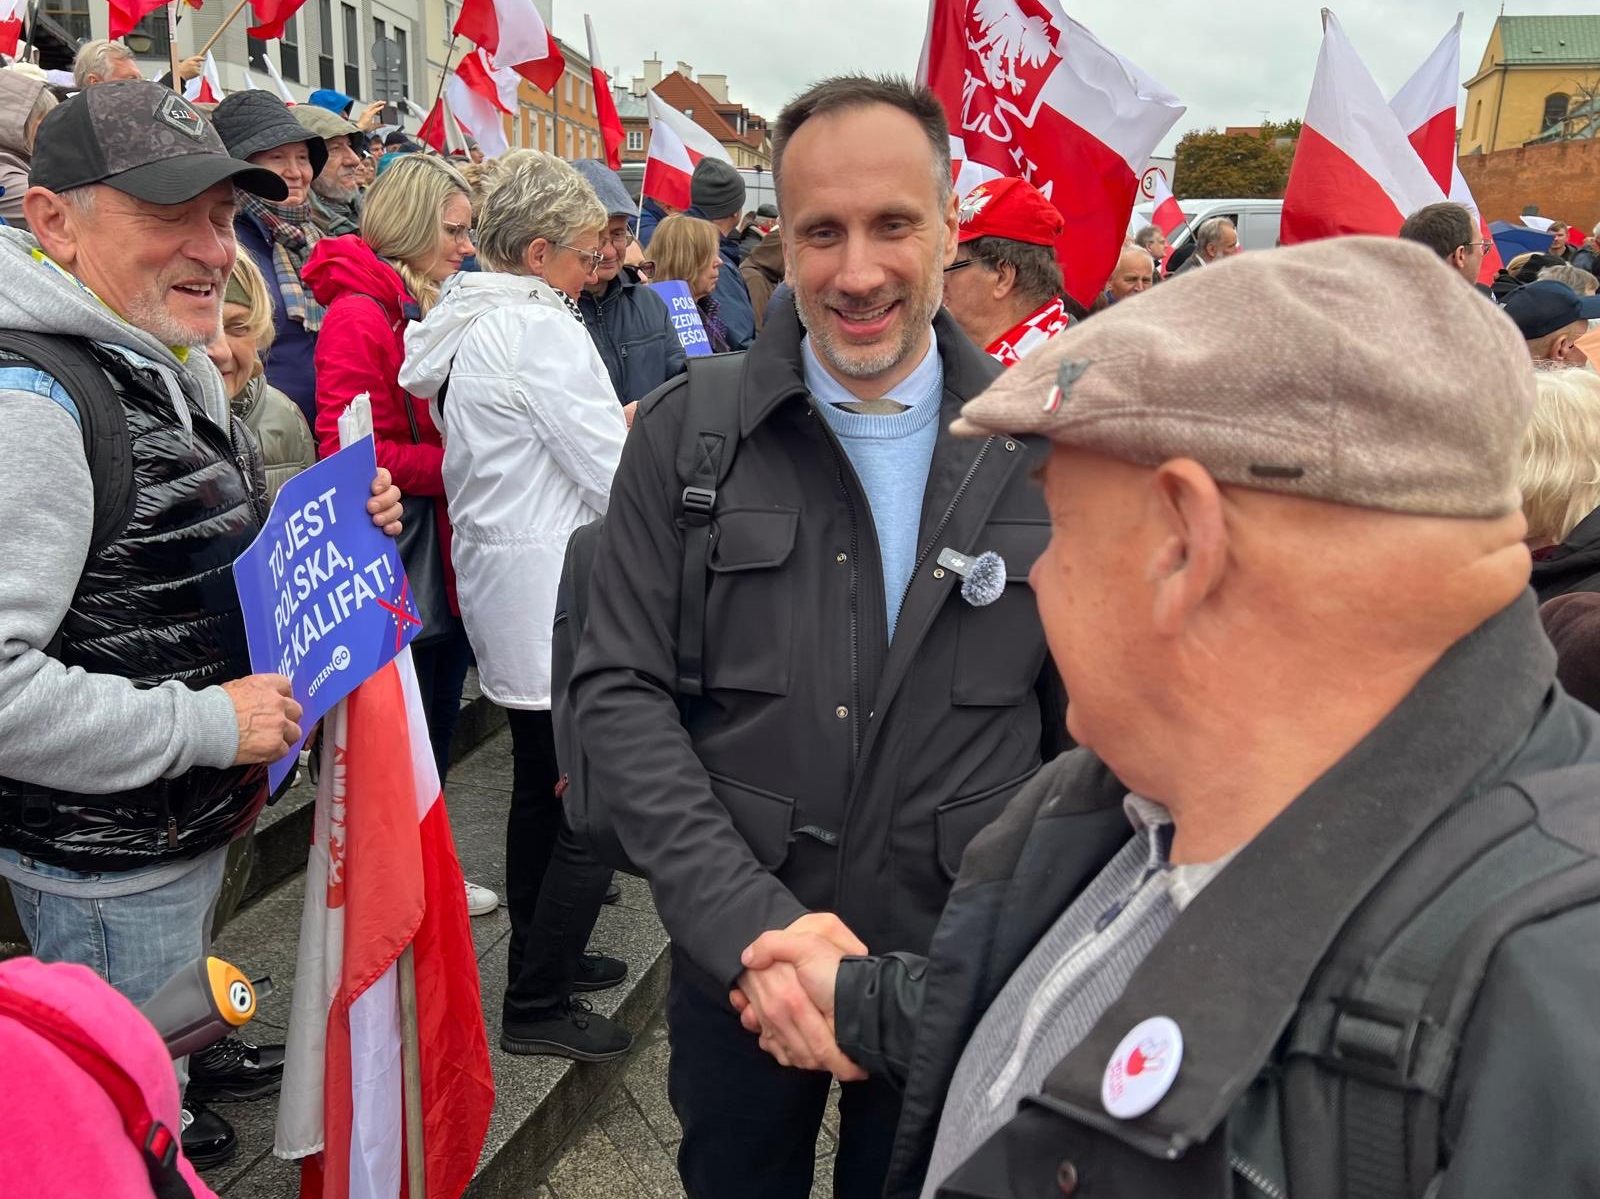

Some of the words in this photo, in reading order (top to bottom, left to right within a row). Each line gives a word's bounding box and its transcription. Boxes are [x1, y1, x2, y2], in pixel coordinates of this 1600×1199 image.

[1144, 176, 1153, 190] 3
[268, 540, 284, 591] TO
[285, 487, 337, 561] JEST
[275, 541, 354, 645] POLSKA,
[278, 644, 294, 686] IE
[291, 553, 395, 667] KALIFAT!
